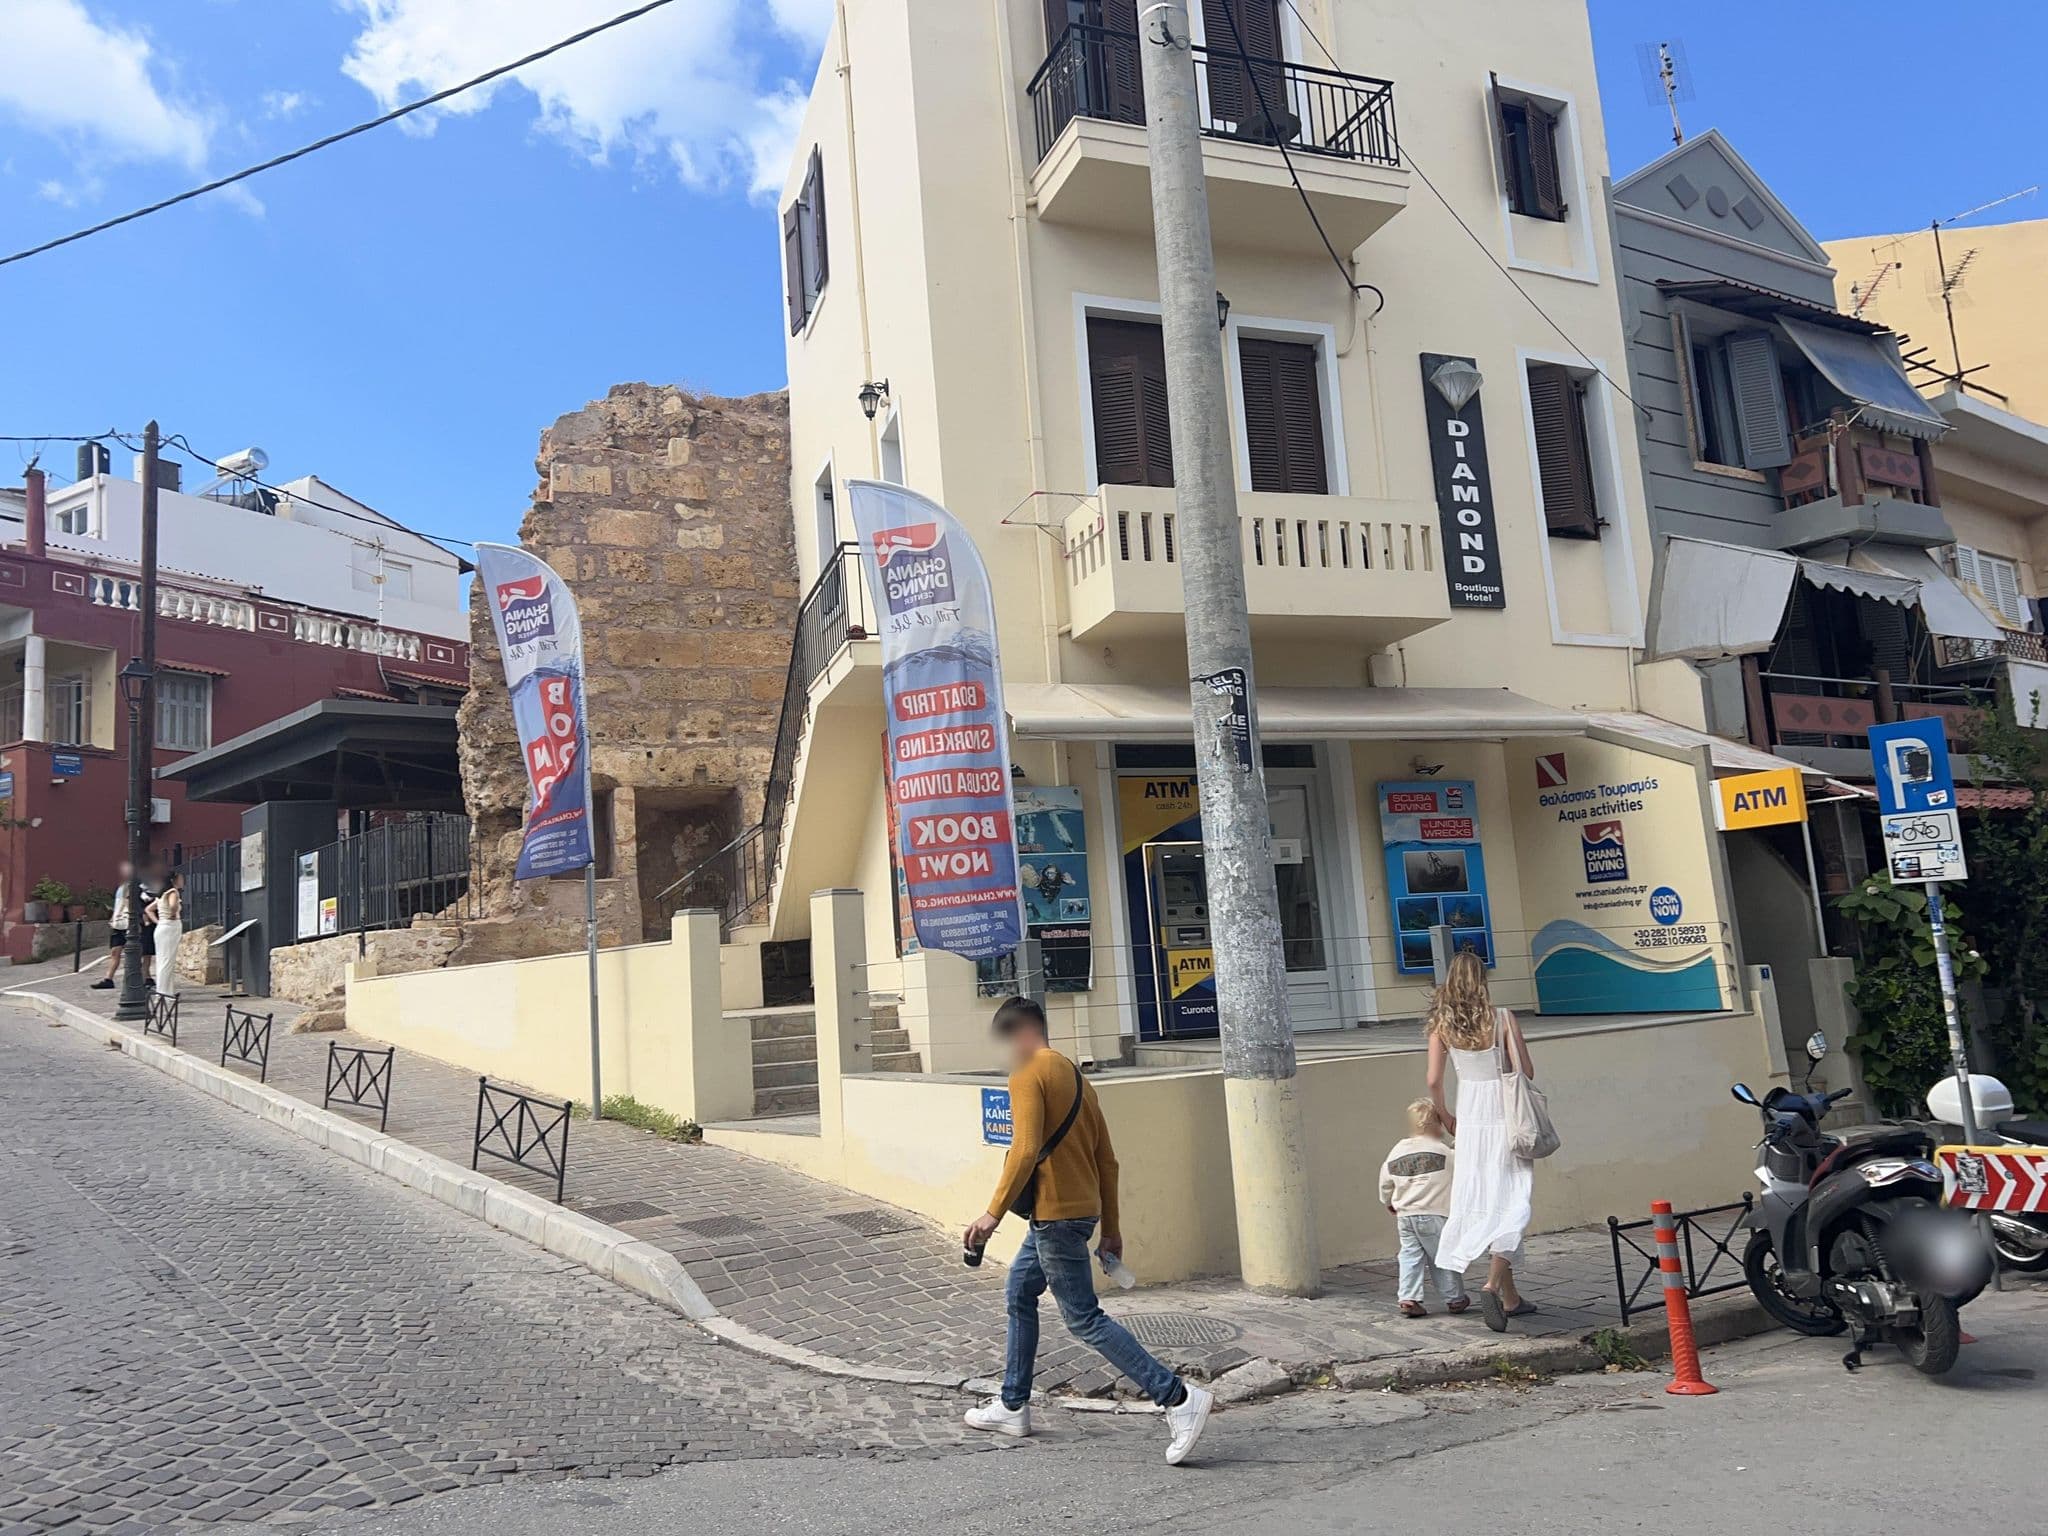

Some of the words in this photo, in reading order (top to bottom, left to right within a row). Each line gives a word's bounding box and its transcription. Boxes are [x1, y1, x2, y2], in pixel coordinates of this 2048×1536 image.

[1447, 419, 1486, 573] DIAMOND
[1454, 583, 1500, 594] Boutique
[1465, 592, 1493, 602] Hotel
[1886, 737, 1935, 810] P
[1144, 781, 1191, 799] ATM
[1539, 785, 1597, 807] Θαλάσσιος
[1598, 776, 1659, 798] Τουρισμός
[1392, 794, 1433, 803] SCUBA
[1733, 787, 1787, 812] ATM
[1394, 803, 1432, 812] DIVING
[1558, 806, 1588, 823] Aqua
[1590, 799, 1644, 818] activities
[1429, 819, 1471, 829] UNIQUE
[1424, 828, 1472, 838] WRECKS
[1586, 848, 1623, 861] CHANIA
[1587, 859, 1625, 873] DIVING
[1652, 894, 1679, 906] BOOK
[1653, 905, 1680, 917] NOW
[1678, 925, 1706, 935] 58939
[1179, 957, 1211, 971] ATM
